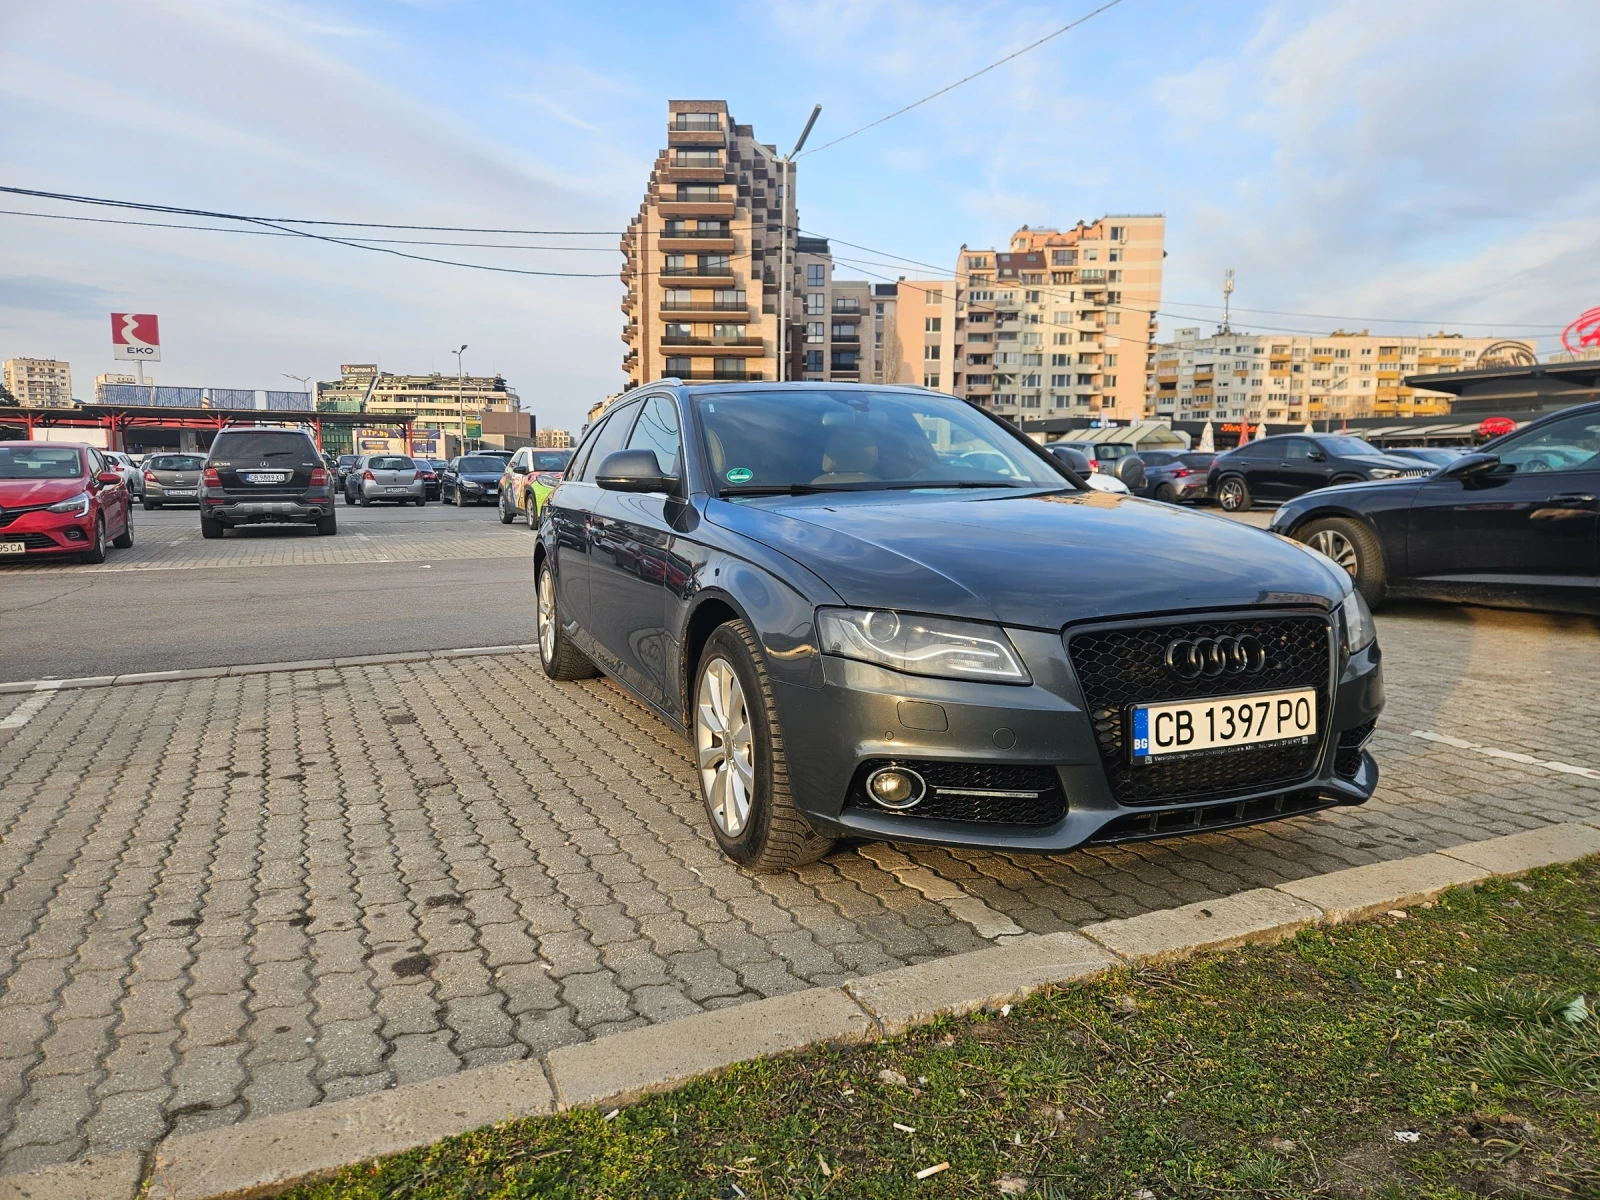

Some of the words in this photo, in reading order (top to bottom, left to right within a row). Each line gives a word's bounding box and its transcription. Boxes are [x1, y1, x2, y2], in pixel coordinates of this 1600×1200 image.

[10, 543, 23, 552] CA
[1155, 710, 1195, 747] CB
[1205, 701, 1271, 742] 1397
[1277, 697, 1311, 733] PO
[1134, 738, 1149, 750] BG
